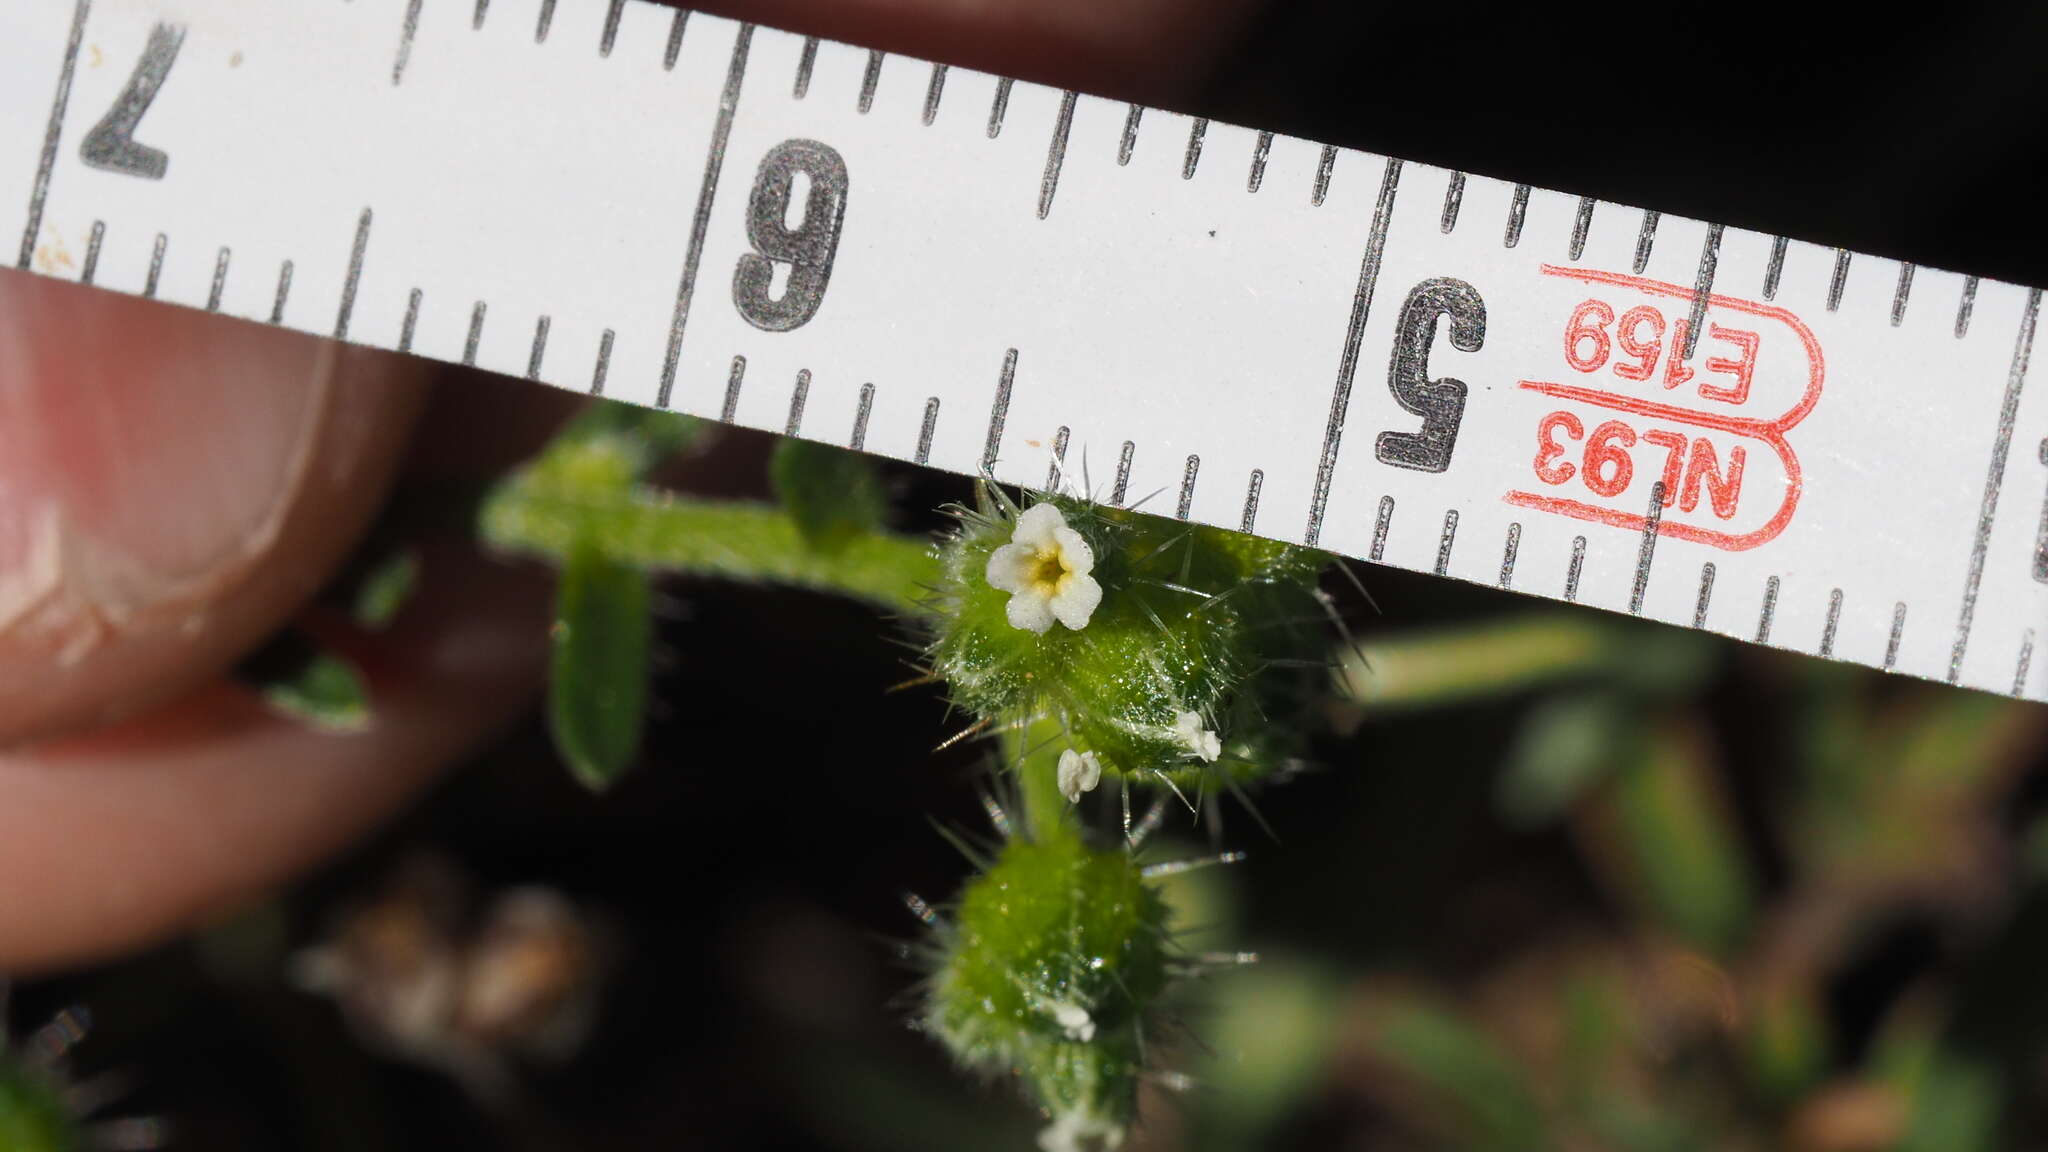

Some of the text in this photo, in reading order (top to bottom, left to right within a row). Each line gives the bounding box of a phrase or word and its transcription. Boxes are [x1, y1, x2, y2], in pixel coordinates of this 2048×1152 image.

[81, 24, 184, 180] 7
[733, 139, 849, 332] 6
[1376, 277, 1487, 473] 5
[1565, 299, 1759, 406] E159
[1534, 411, 1746, 521] NL93
